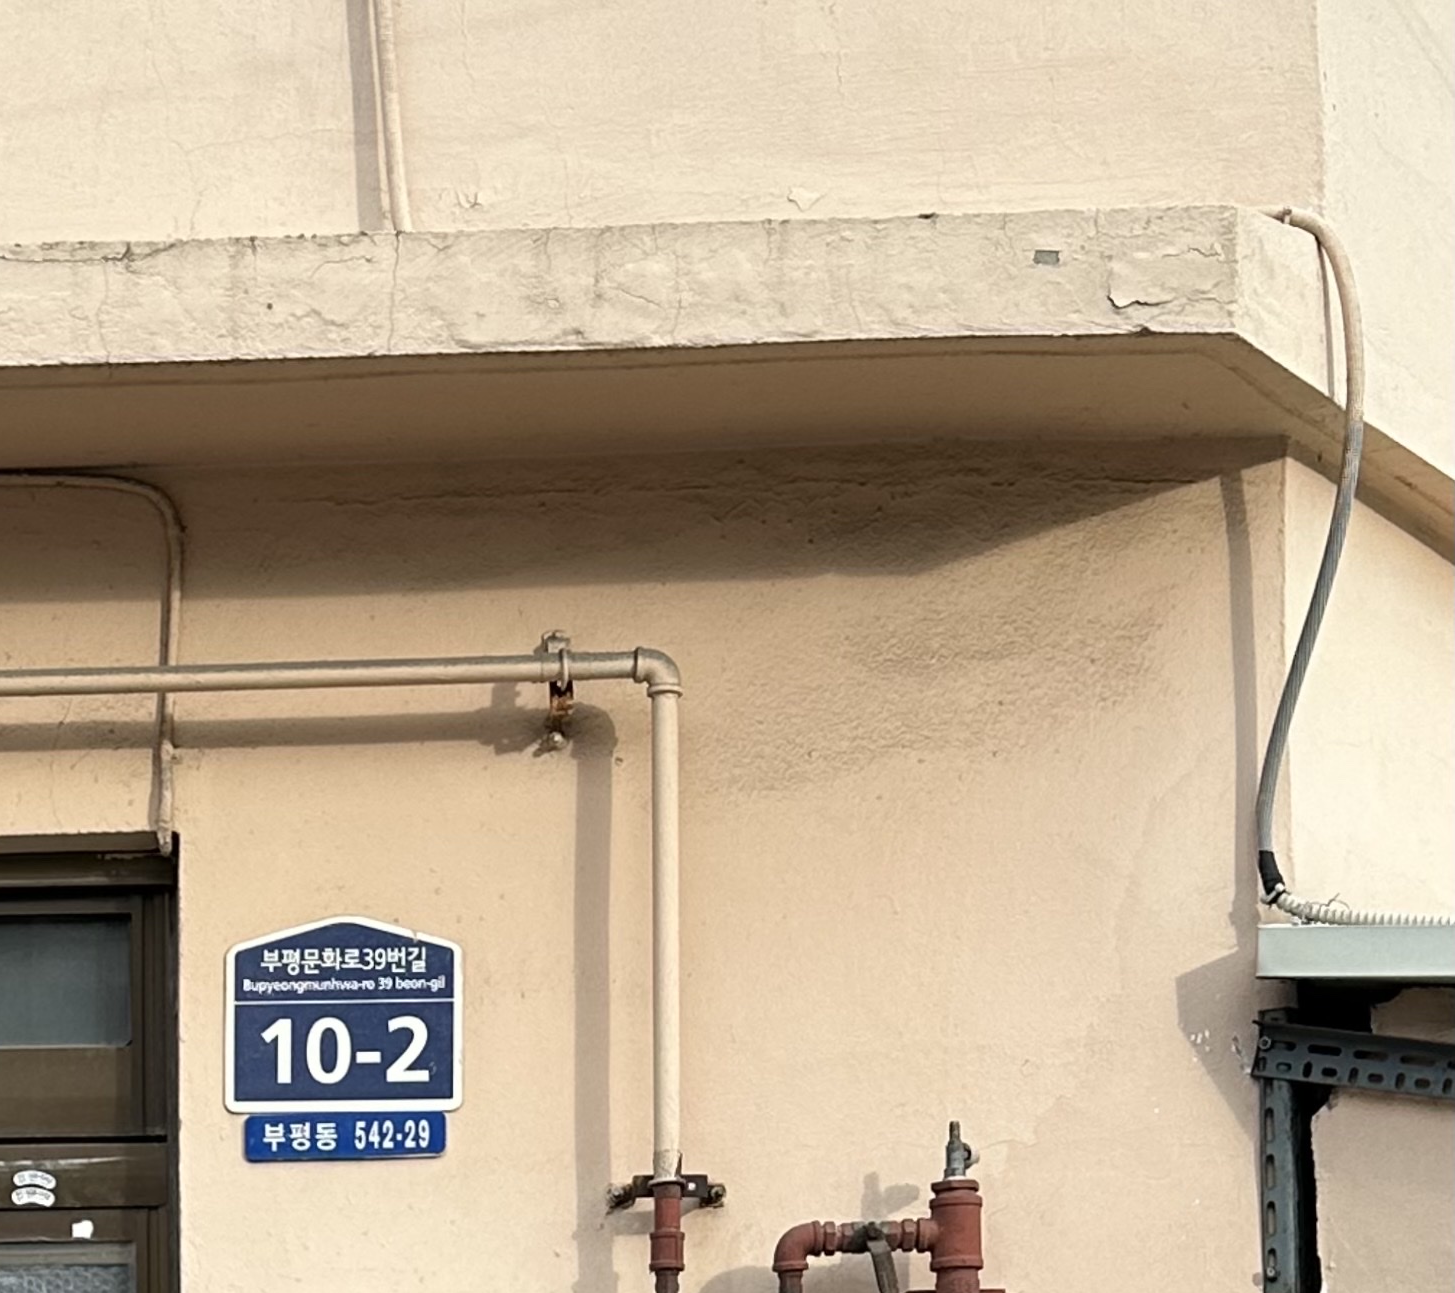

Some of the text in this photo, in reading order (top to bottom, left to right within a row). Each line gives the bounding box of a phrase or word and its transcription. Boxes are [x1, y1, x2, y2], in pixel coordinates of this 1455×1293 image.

[260, 946, 427, 975] 부평문화로39번길
[243, 975, 446, 994] Bupyeongmunhwa-ro 39 beon-gil
[260, 1015, 430, 1084] 10-2
[262, 1119, 430, 1152] 부평동 542-29
